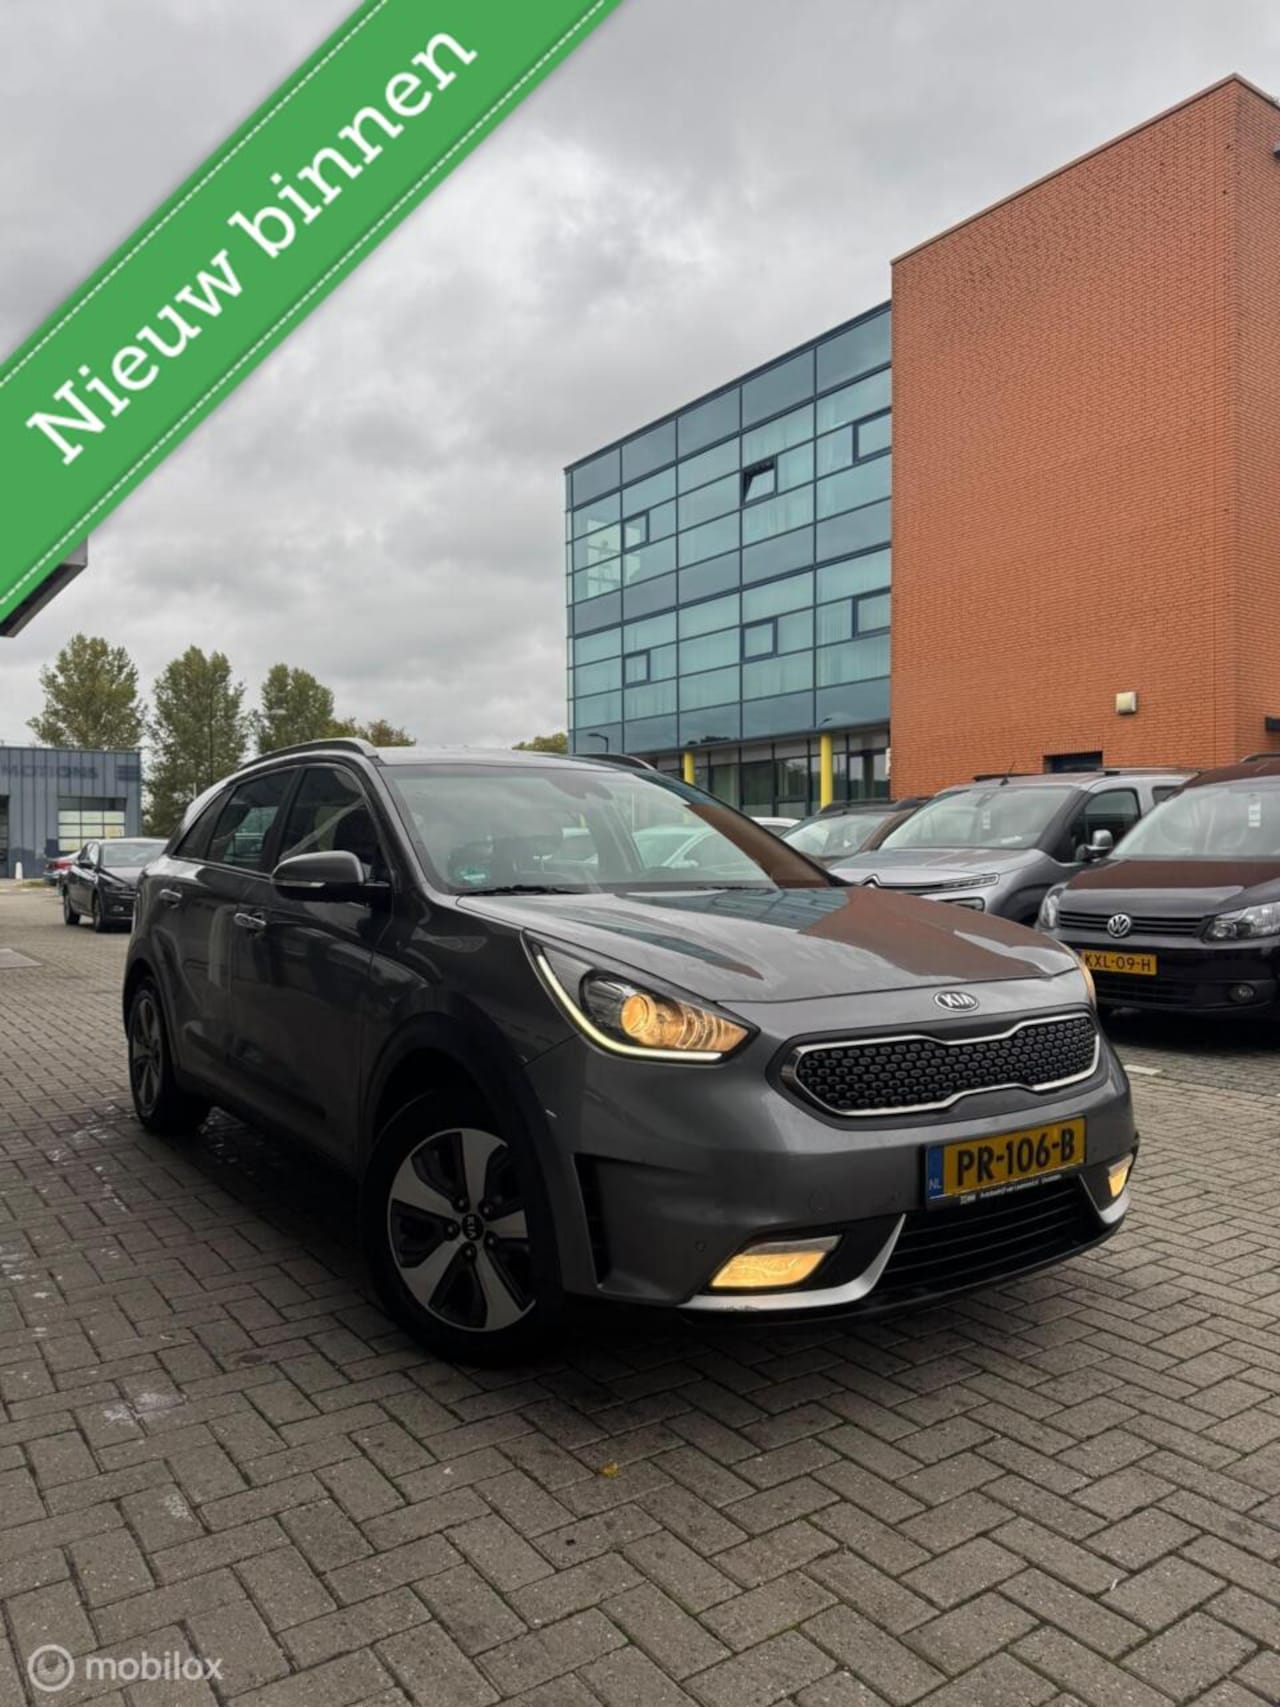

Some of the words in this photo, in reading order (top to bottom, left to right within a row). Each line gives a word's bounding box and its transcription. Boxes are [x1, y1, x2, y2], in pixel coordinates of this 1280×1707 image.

[1084, 953, 1152, 972] KXL-09-H
[939, 992, 977, 1008] KIA
[957, 1127, 1075, 1186] PR-106-B
[928, 1177, 942, 1190] NL
